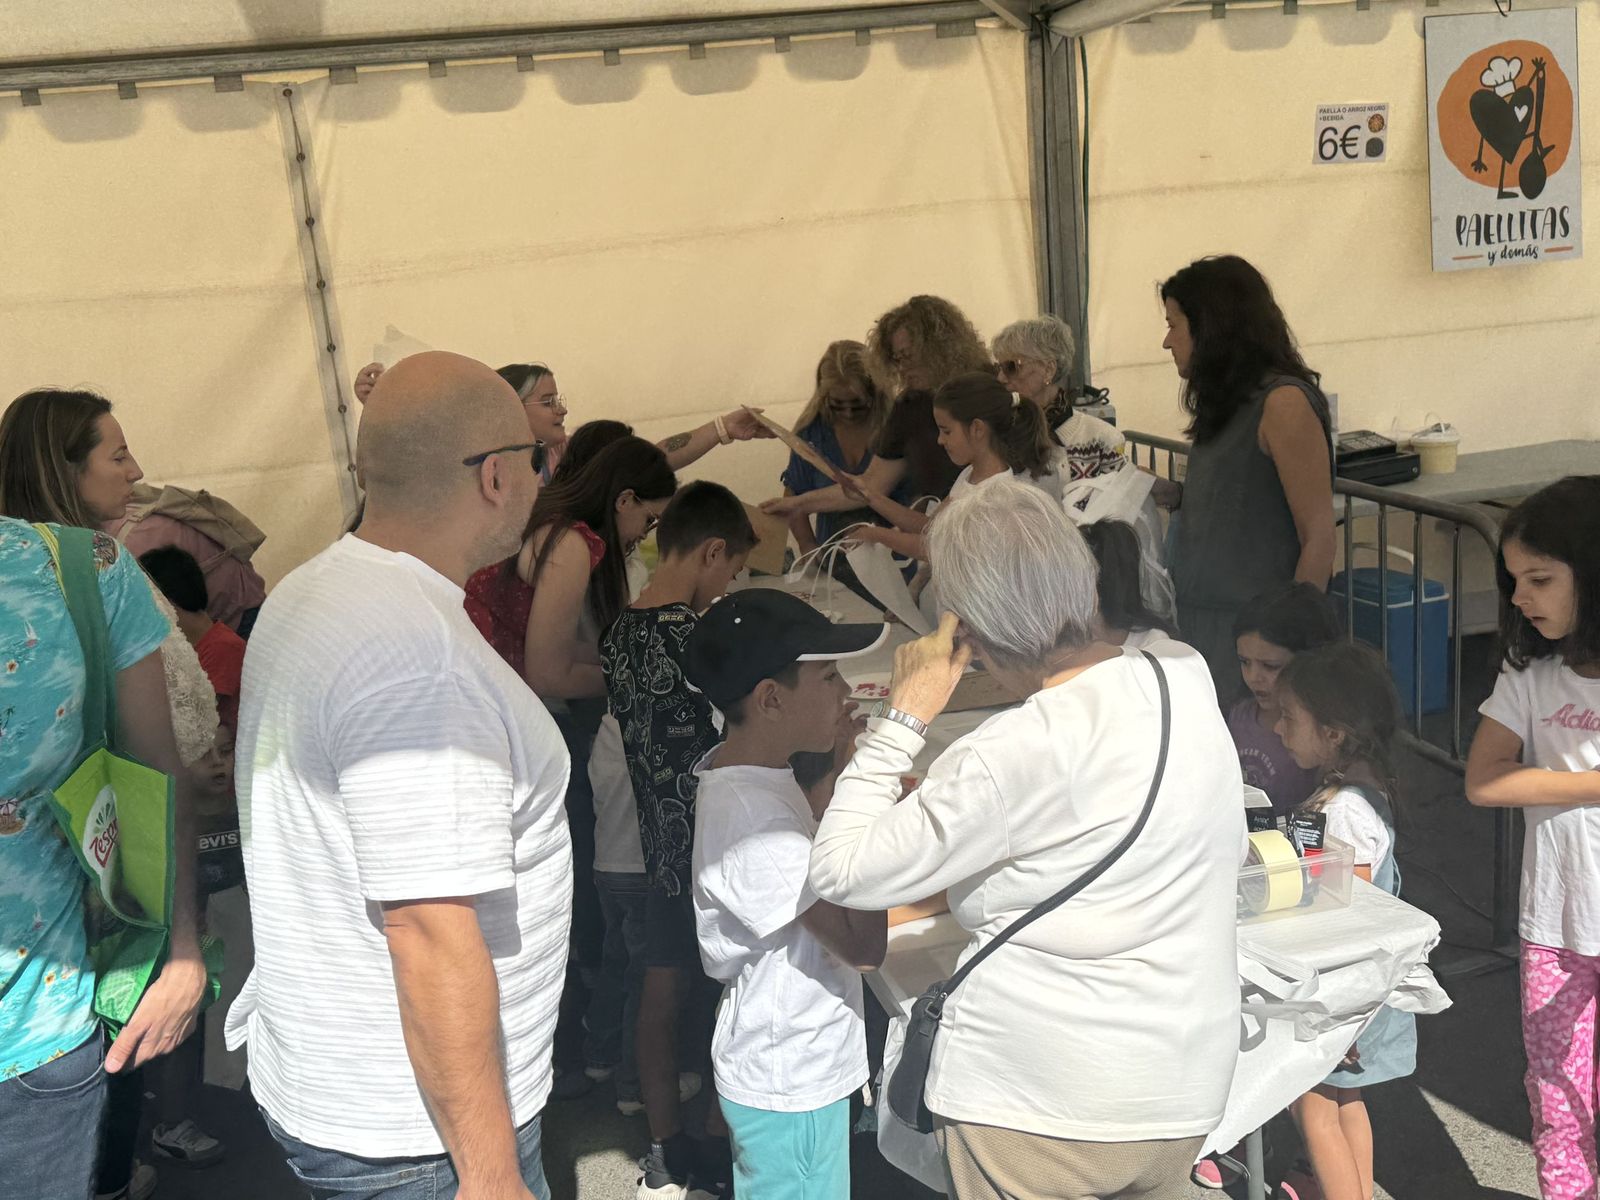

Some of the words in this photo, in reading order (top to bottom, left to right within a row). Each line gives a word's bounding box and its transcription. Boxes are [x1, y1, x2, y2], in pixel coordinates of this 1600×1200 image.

[1318, 125, 1362, 161] 6€
[1455, 205, 1570, 247] PAELLITAS
[1487, 250, 1498, 266] y
[1500, 244, 1539, 259] demás
[89, 816, 119, 869] Zespr
